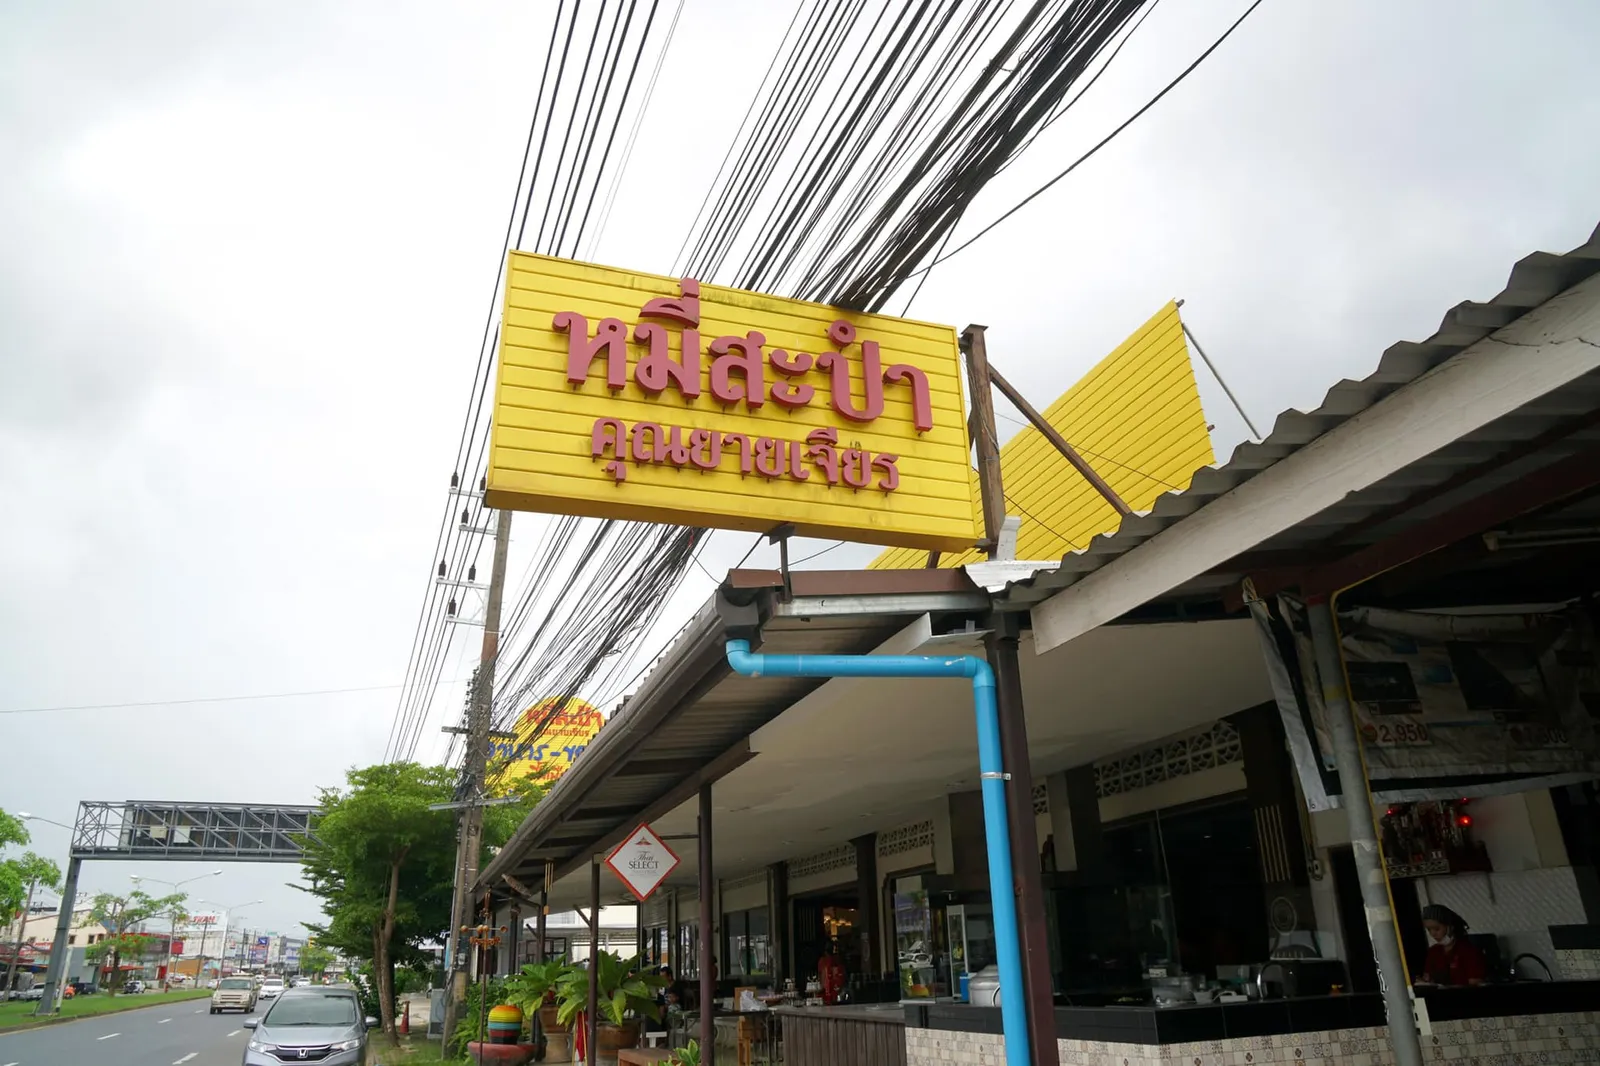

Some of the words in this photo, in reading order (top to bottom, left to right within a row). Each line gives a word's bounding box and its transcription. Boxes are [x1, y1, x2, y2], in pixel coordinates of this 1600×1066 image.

[552, 278, 932, 432] หมี่สะปำ
[591, 417, 899, 491] คุณยายเจียร
[628, 861, 659, 870] SELECT
